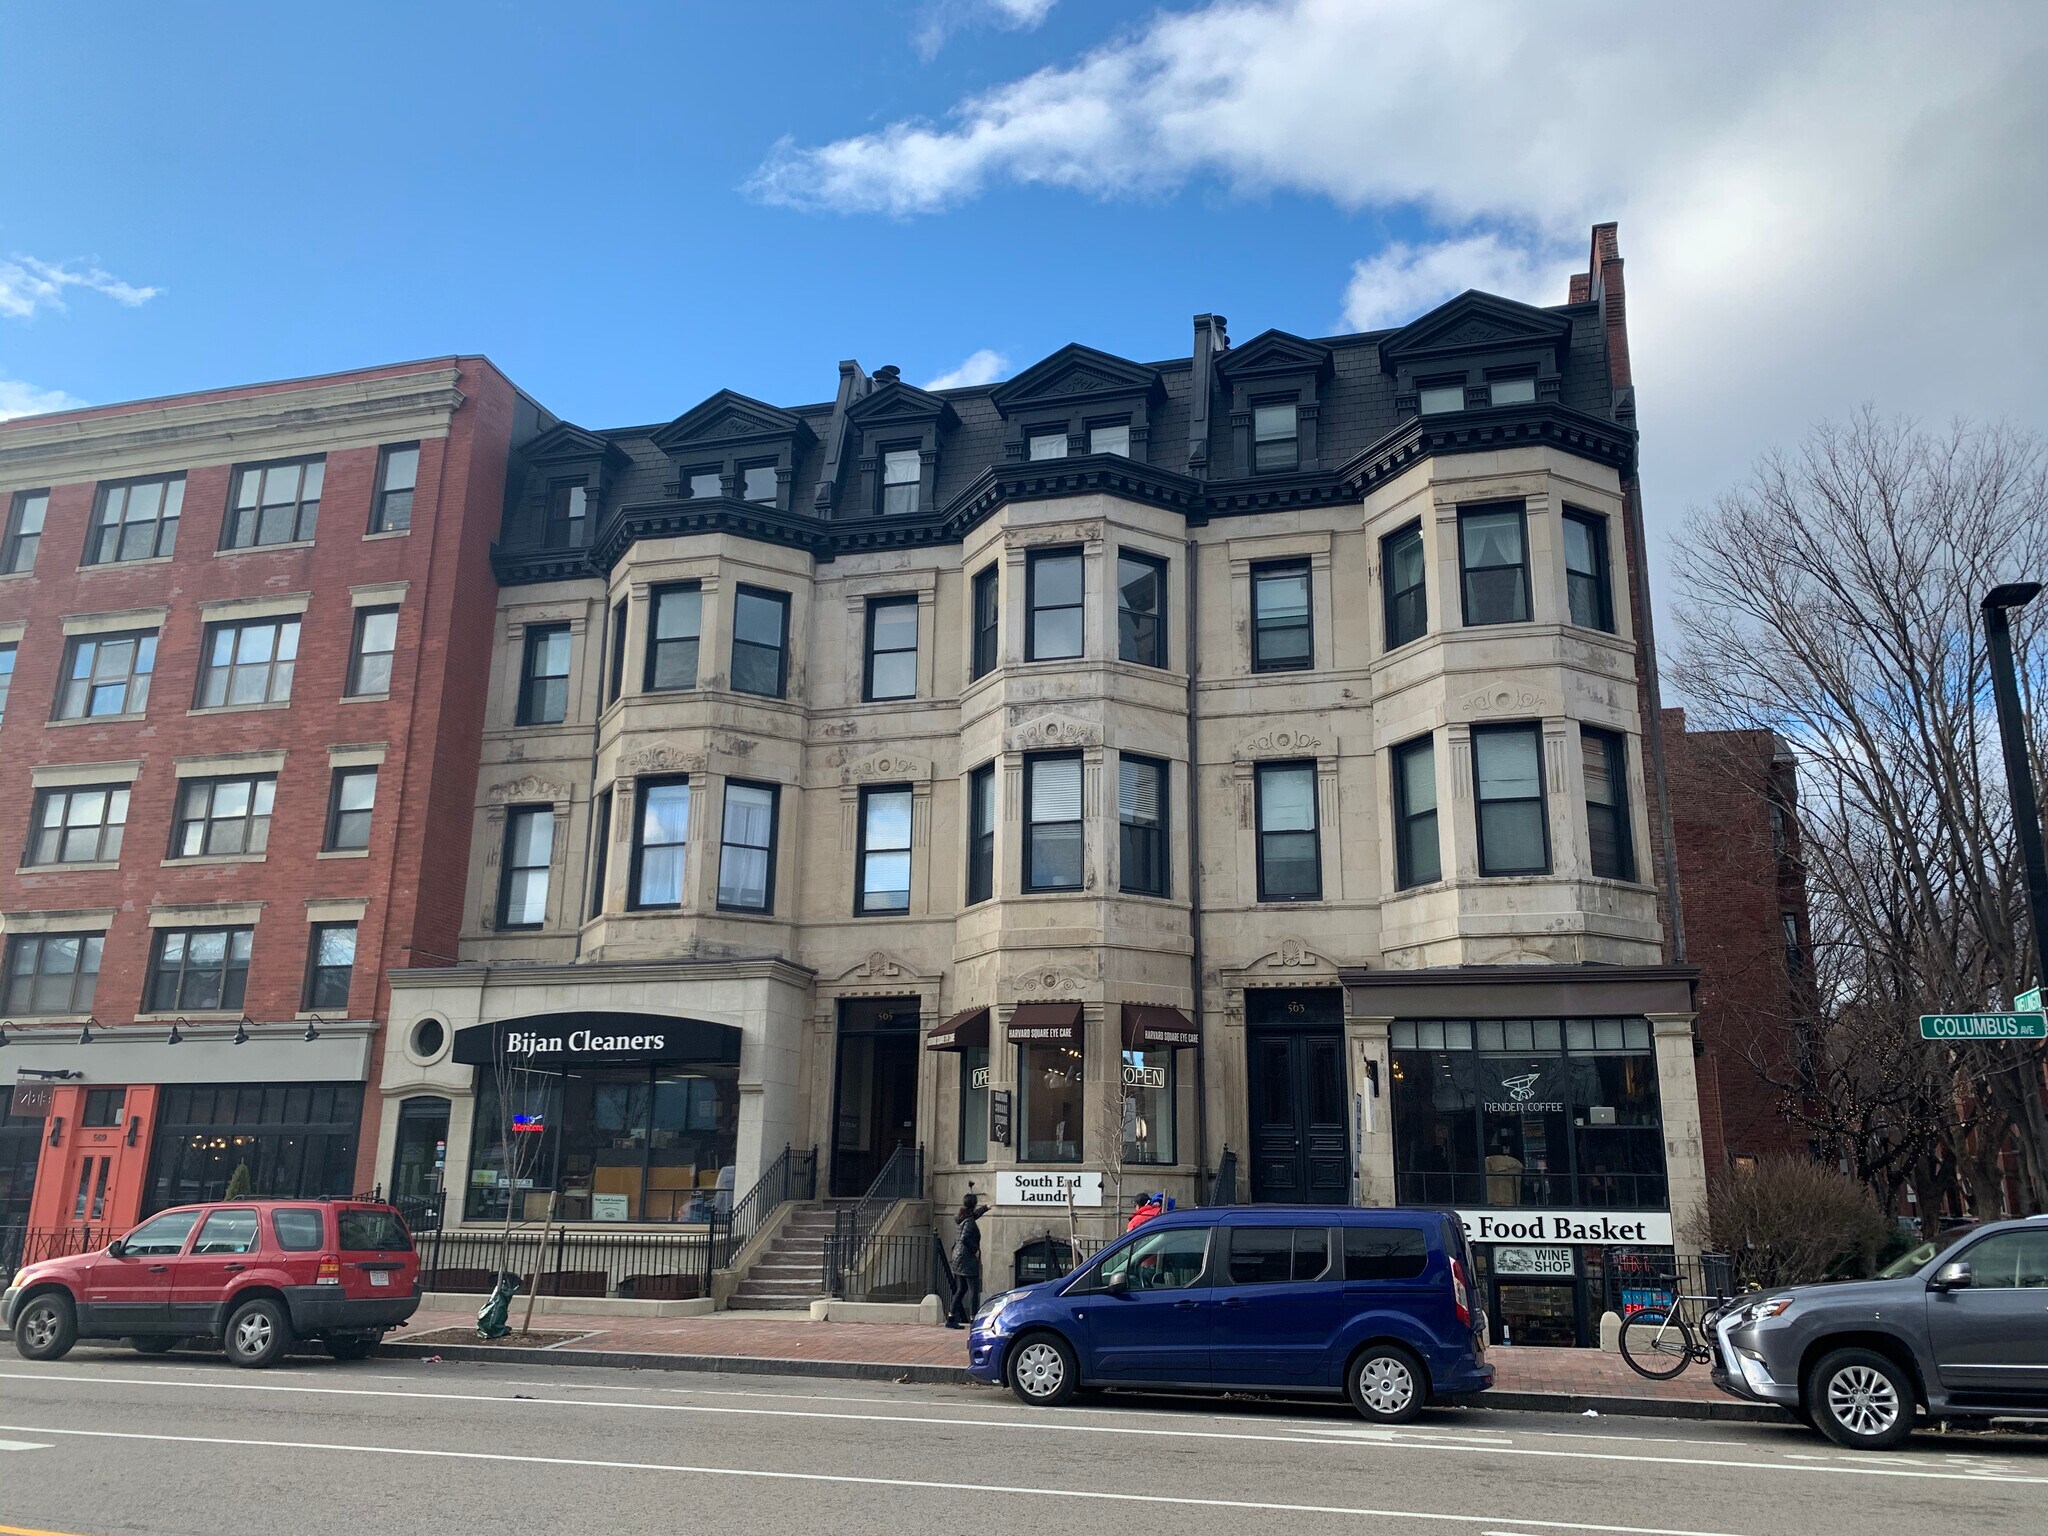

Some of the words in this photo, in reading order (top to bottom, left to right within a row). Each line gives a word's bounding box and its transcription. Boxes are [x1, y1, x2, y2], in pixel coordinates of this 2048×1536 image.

[1008, 1028, 1031, 1038] HARVARD
[1031, 1028, 1049, 1039] SQUARE
[1049, 1028, 1059, 1038] EYE
[1059, 1028, 1072, 1038] CARE
[1933, 1017, 2018, 1036] COLUMBUS
[2020, 1025, 2035, 1035] AVE
[506, 1032, 563, 1058] Bijan
[568, 1030, 665, 1052] Cleaners
[1144, 1030, 1164, 1041] HARVARD
[1164, 1031, 1180, 1043] SQUARE
[1180, 1033, 1188, 1043] EYE
[1188, 1033, 1199, 1044] CARE
[974, 1069, 989, 1087] OPE
[1124, 1067, 1162, 1086] OPEN
[1484, 1102, 1525, 1114] RENDER
[1527, 1102, 1564, 1112] COFFEE
[1015, 1175, 1053, 1188] South
[1478, 1216, 1546, 1239] Food
[1553, 1217, 1647, 1240] Basket
[1534, 1249, 1570, 1261] WINE
[1534, 1261, 1571, 1273] SHOP
